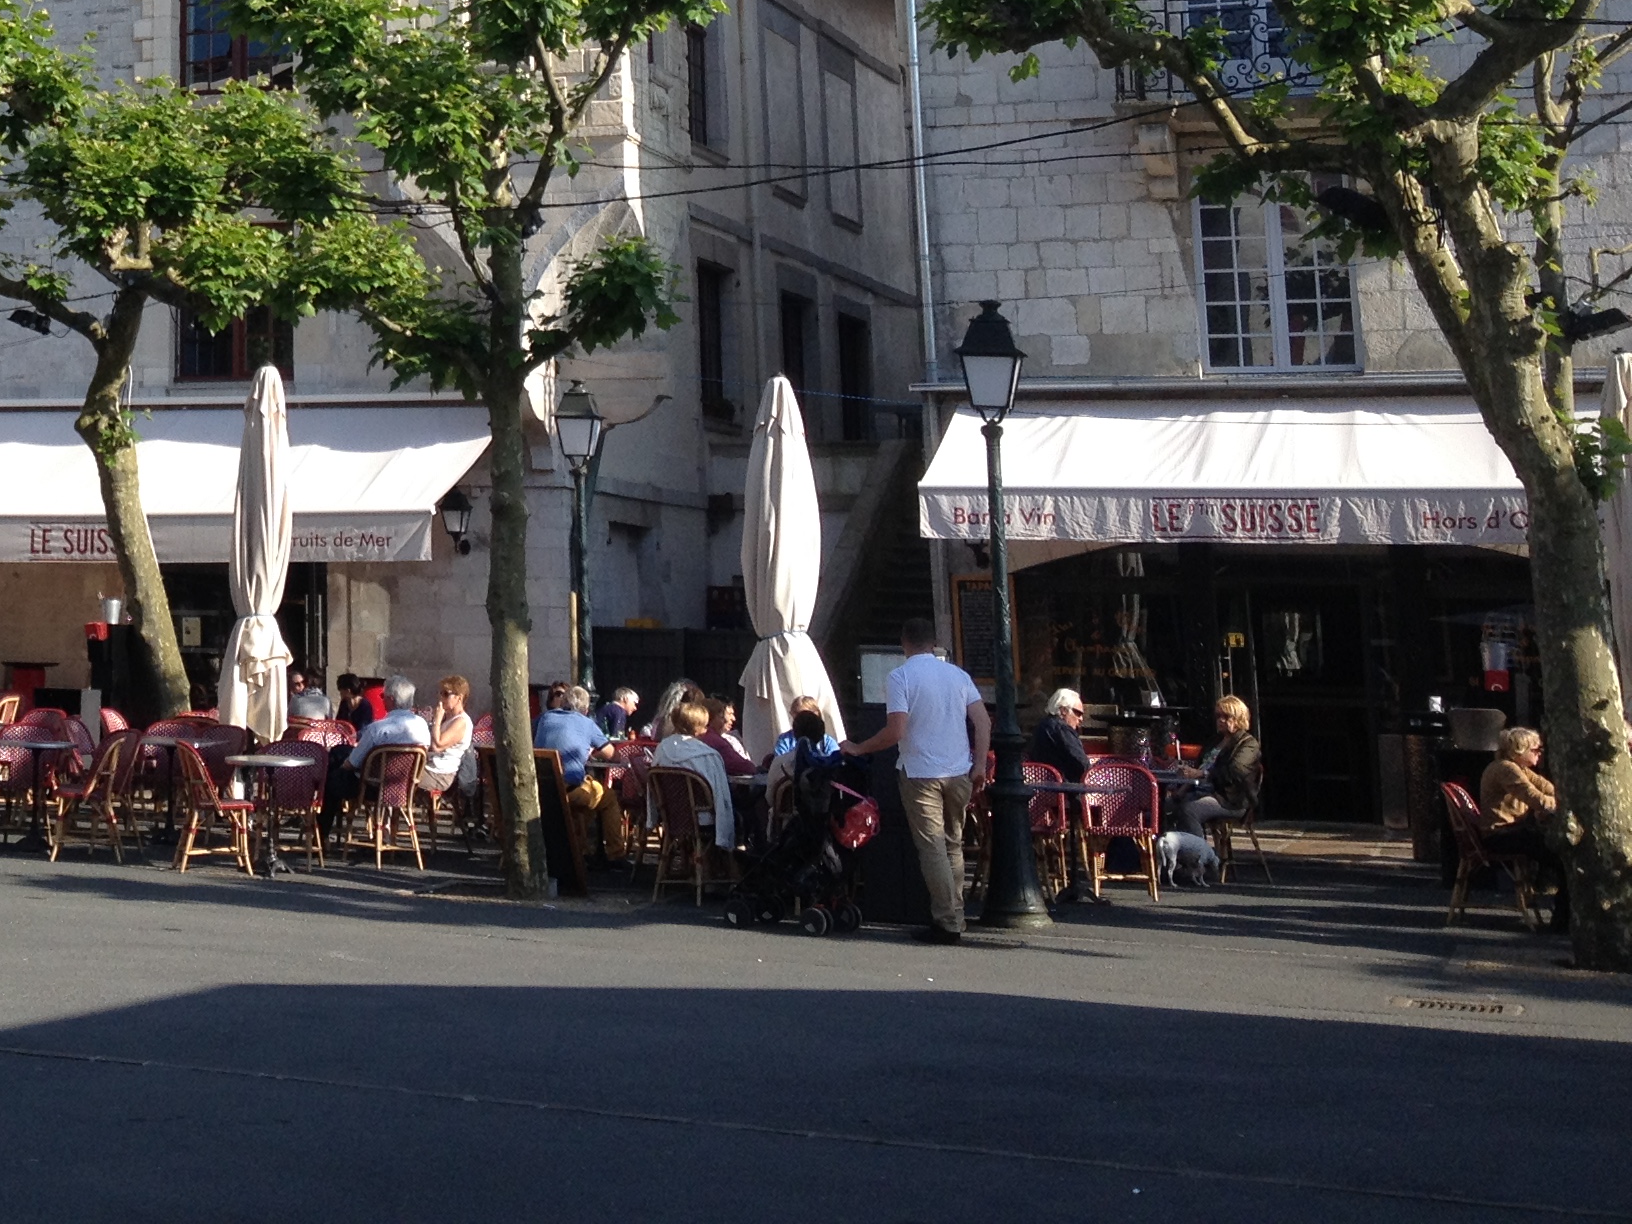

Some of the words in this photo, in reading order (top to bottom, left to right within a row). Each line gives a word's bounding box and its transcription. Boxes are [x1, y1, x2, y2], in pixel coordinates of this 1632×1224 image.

[953, 507, 989, 525] Bar
[1020, 507, 1057, 525] Vin
[1152, 504, 1183, 533] LE
[1221, 503, 1320, 534] SUISSE
[1422, 510, 1478, 530] Hors
[30, 528, 52, 555] LE
[63, 528, 117, 555] SUIS
[292, 531, 327, 548] ruits
[333, 530, 354, 548] de
[359, 532, 393, 548] Mer
